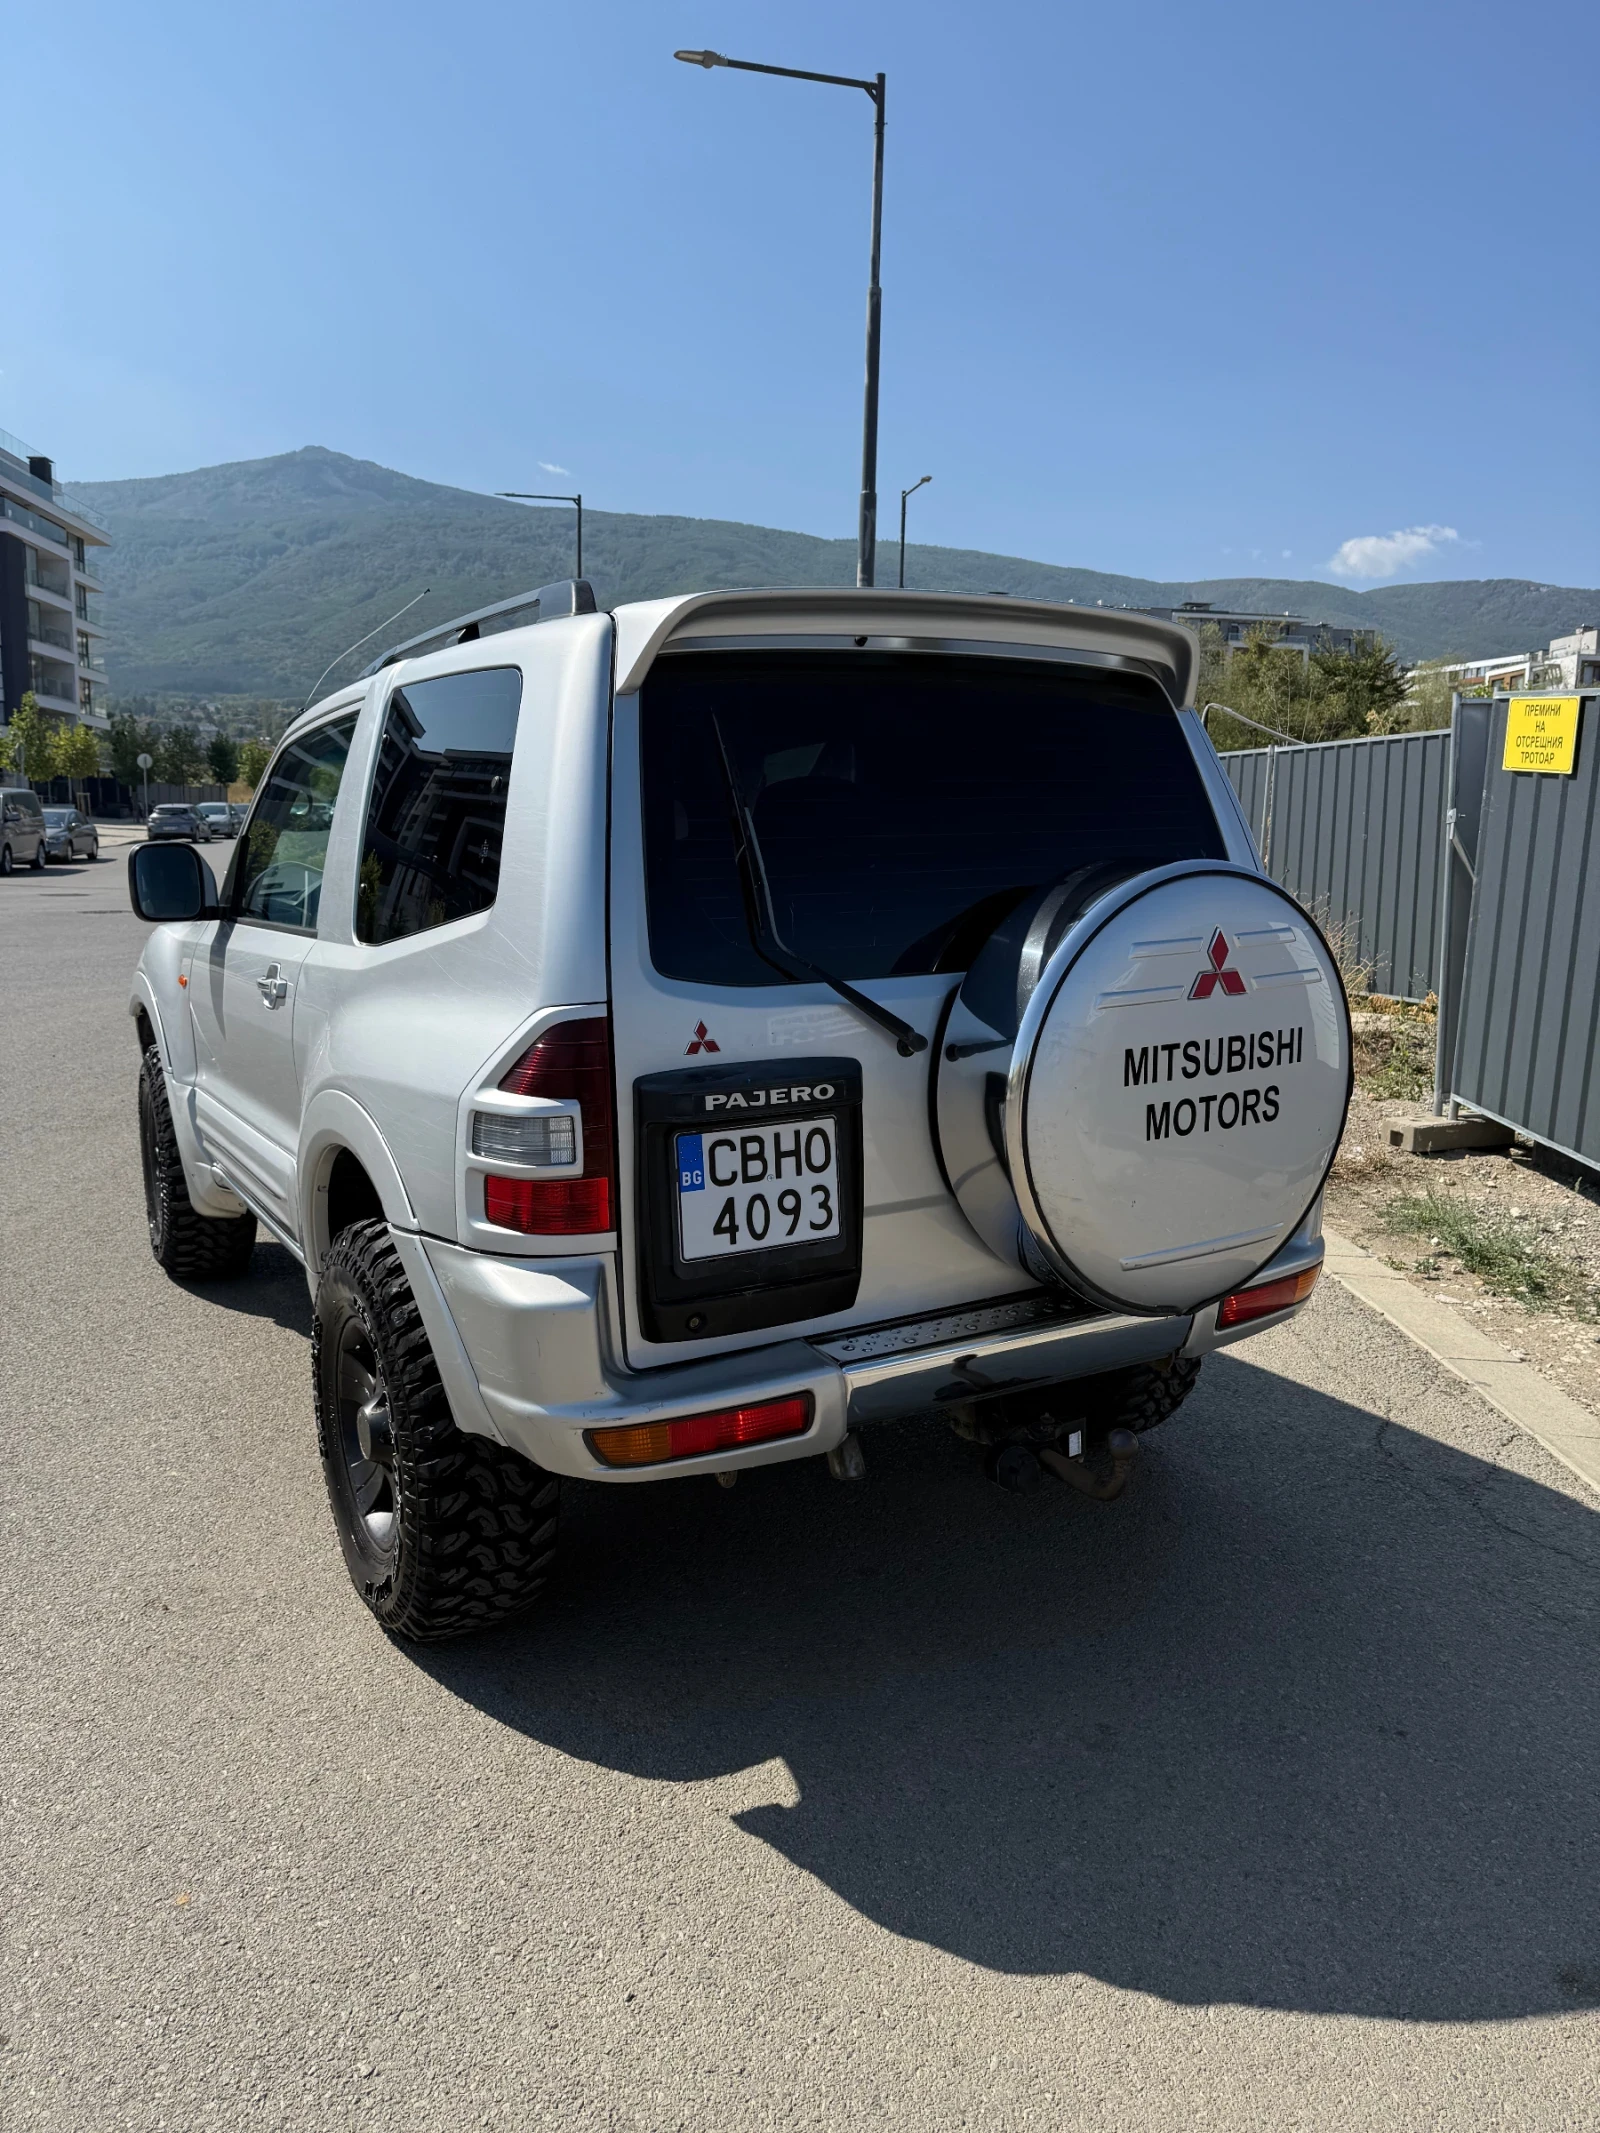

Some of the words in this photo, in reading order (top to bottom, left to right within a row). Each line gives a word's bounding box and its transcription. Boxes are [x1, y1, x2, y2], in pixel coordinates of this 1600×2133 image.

[1524, 704, 1561, 716] ПРЕМИНИ
[1535, 720, 1545, 733] НА
[1516, 735, 1563, 750] ОТСРЕЩНИЯ
[1521, 751, 1555, 764] ТРОТОАР
[1123, 1026, 1302, 1087] MITSUBISHI
[705, 1083, 835, 1111] PAJERO
[1146, 1085, 1280, 1141] MOTORS
[682, 1170, 702, 1187] BG
[713, 1184, 833, 1245] 4093
